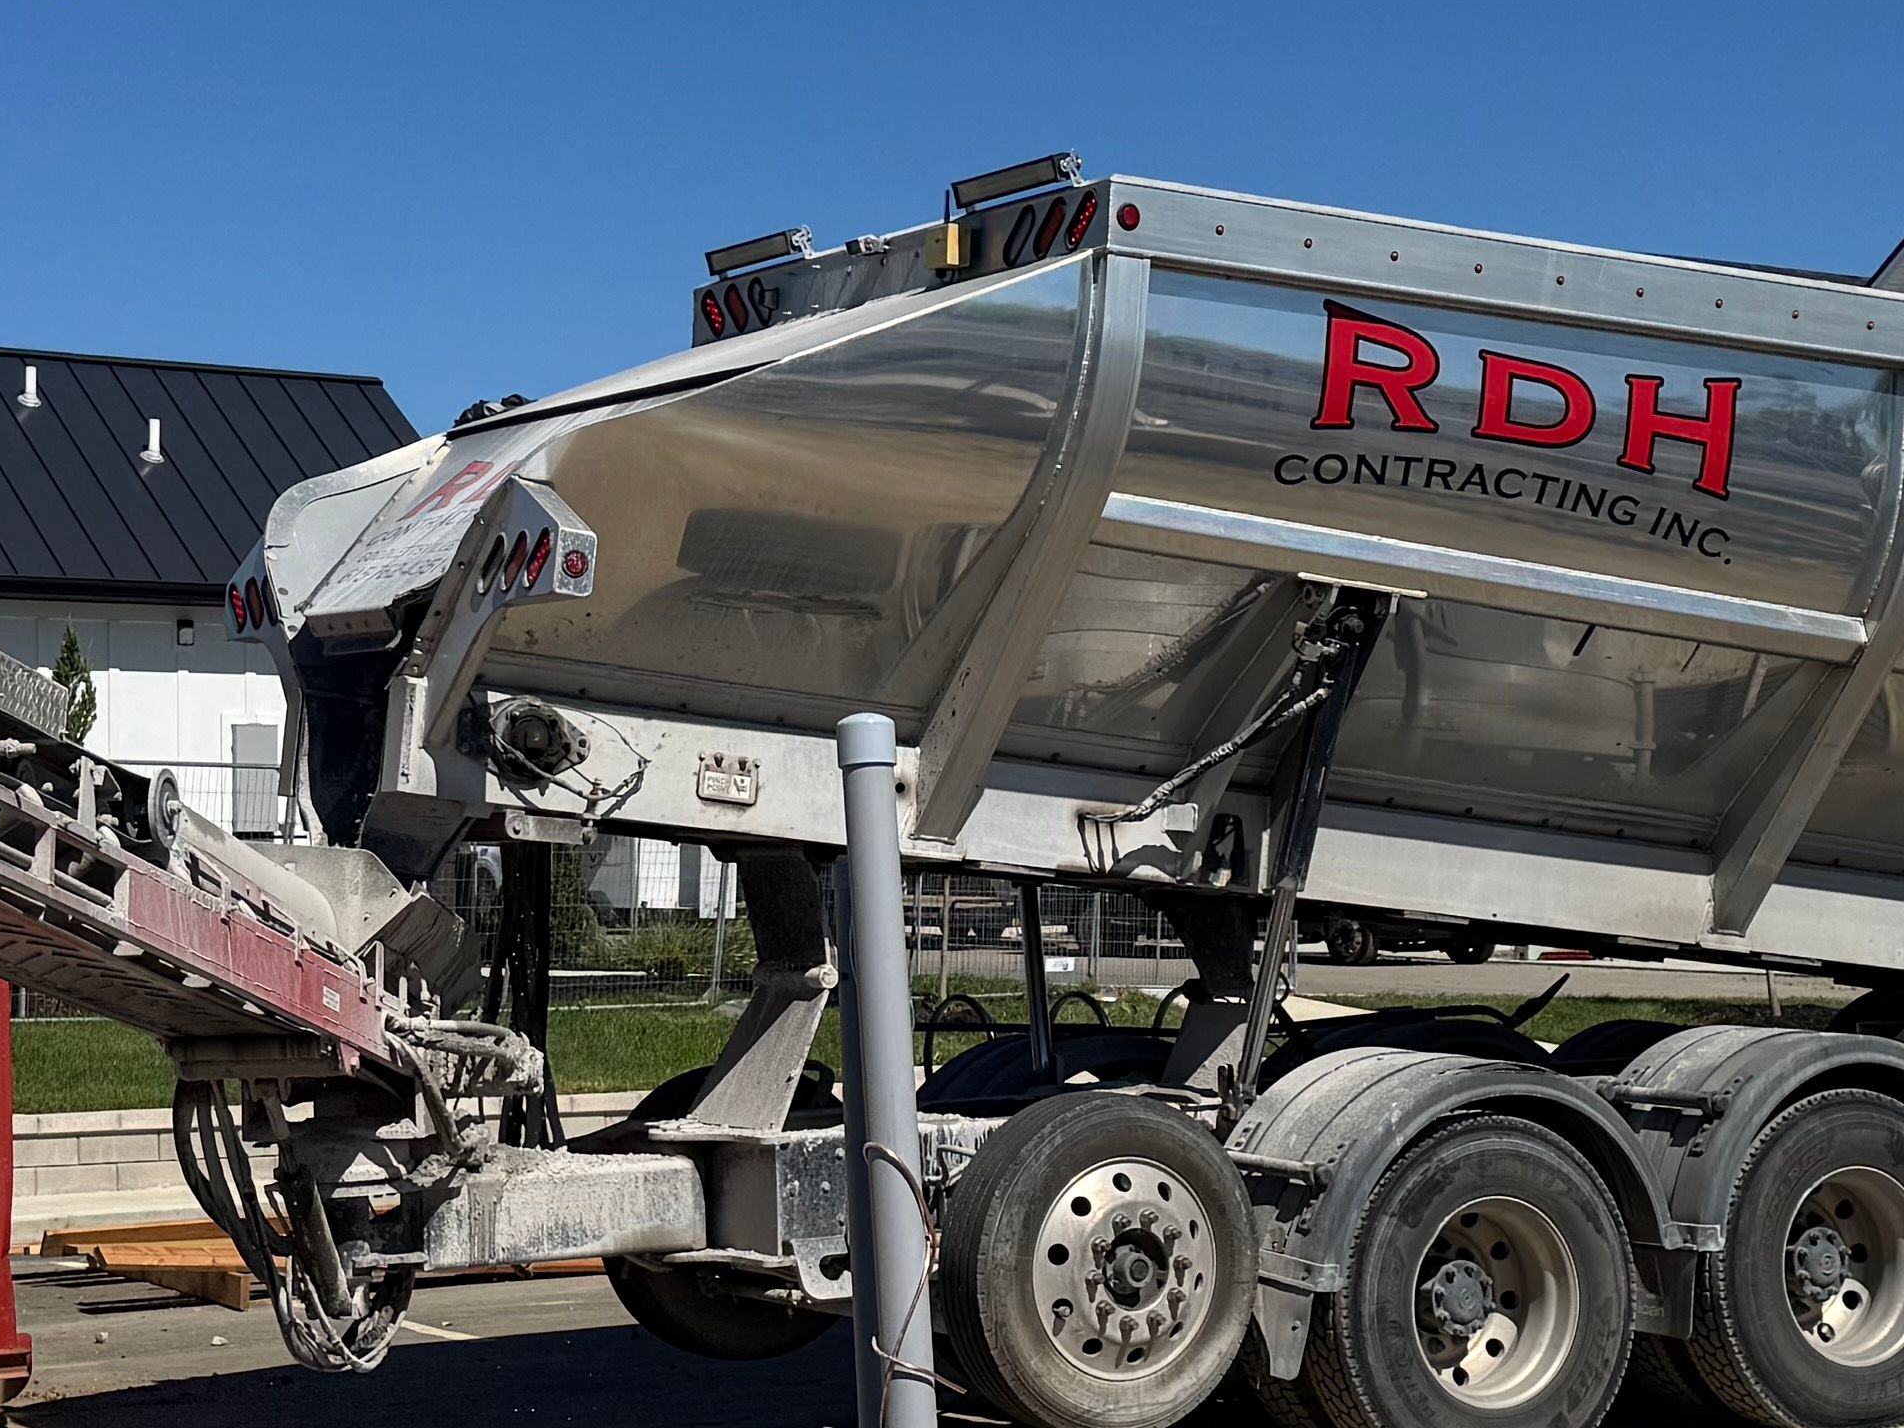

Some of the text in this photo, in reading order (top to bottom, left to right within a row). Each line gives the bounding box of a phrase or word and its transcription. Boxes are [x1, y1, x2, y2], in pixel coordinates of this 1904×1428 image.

[1309, 298, 1742, 501] RDH
[1273, 452, 1733, 566] CONTRACTING INC.
